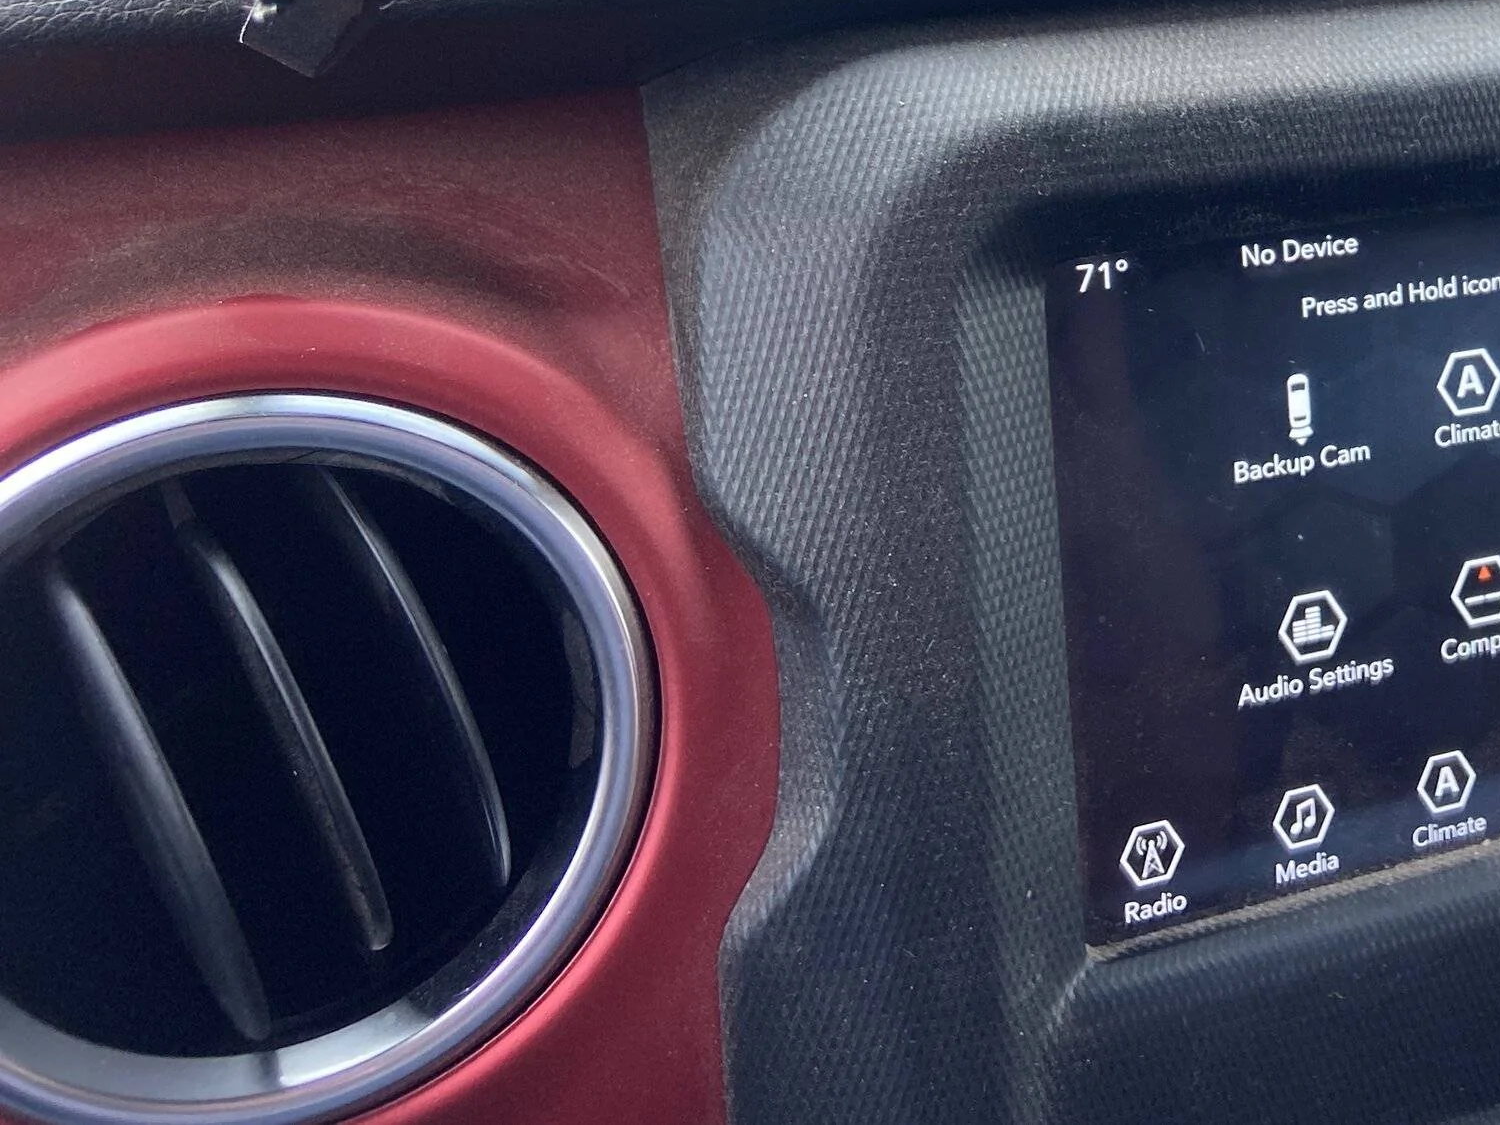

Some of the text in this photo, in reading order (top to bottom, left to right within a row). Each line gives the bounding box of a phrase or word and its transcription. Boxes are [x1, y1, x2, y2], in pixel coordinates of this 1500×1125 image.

[1242, 235, 1359, 267] No Device
[1076, 259, 1128, 292] 71°
[1302, 297, 1358, 318] Press
[1363, 283, 1403, 309] and
[1409, 275, 1457, 302] Hold
[1234, 445, 1370, 483] Backup Cam
[1238, 656, 1394, 709] Audio Settings
[1413, 815, 1487, 847] Climate
[1276, 851, 1341, 887] Media
[1125, 893, 1190, 927] Radio
